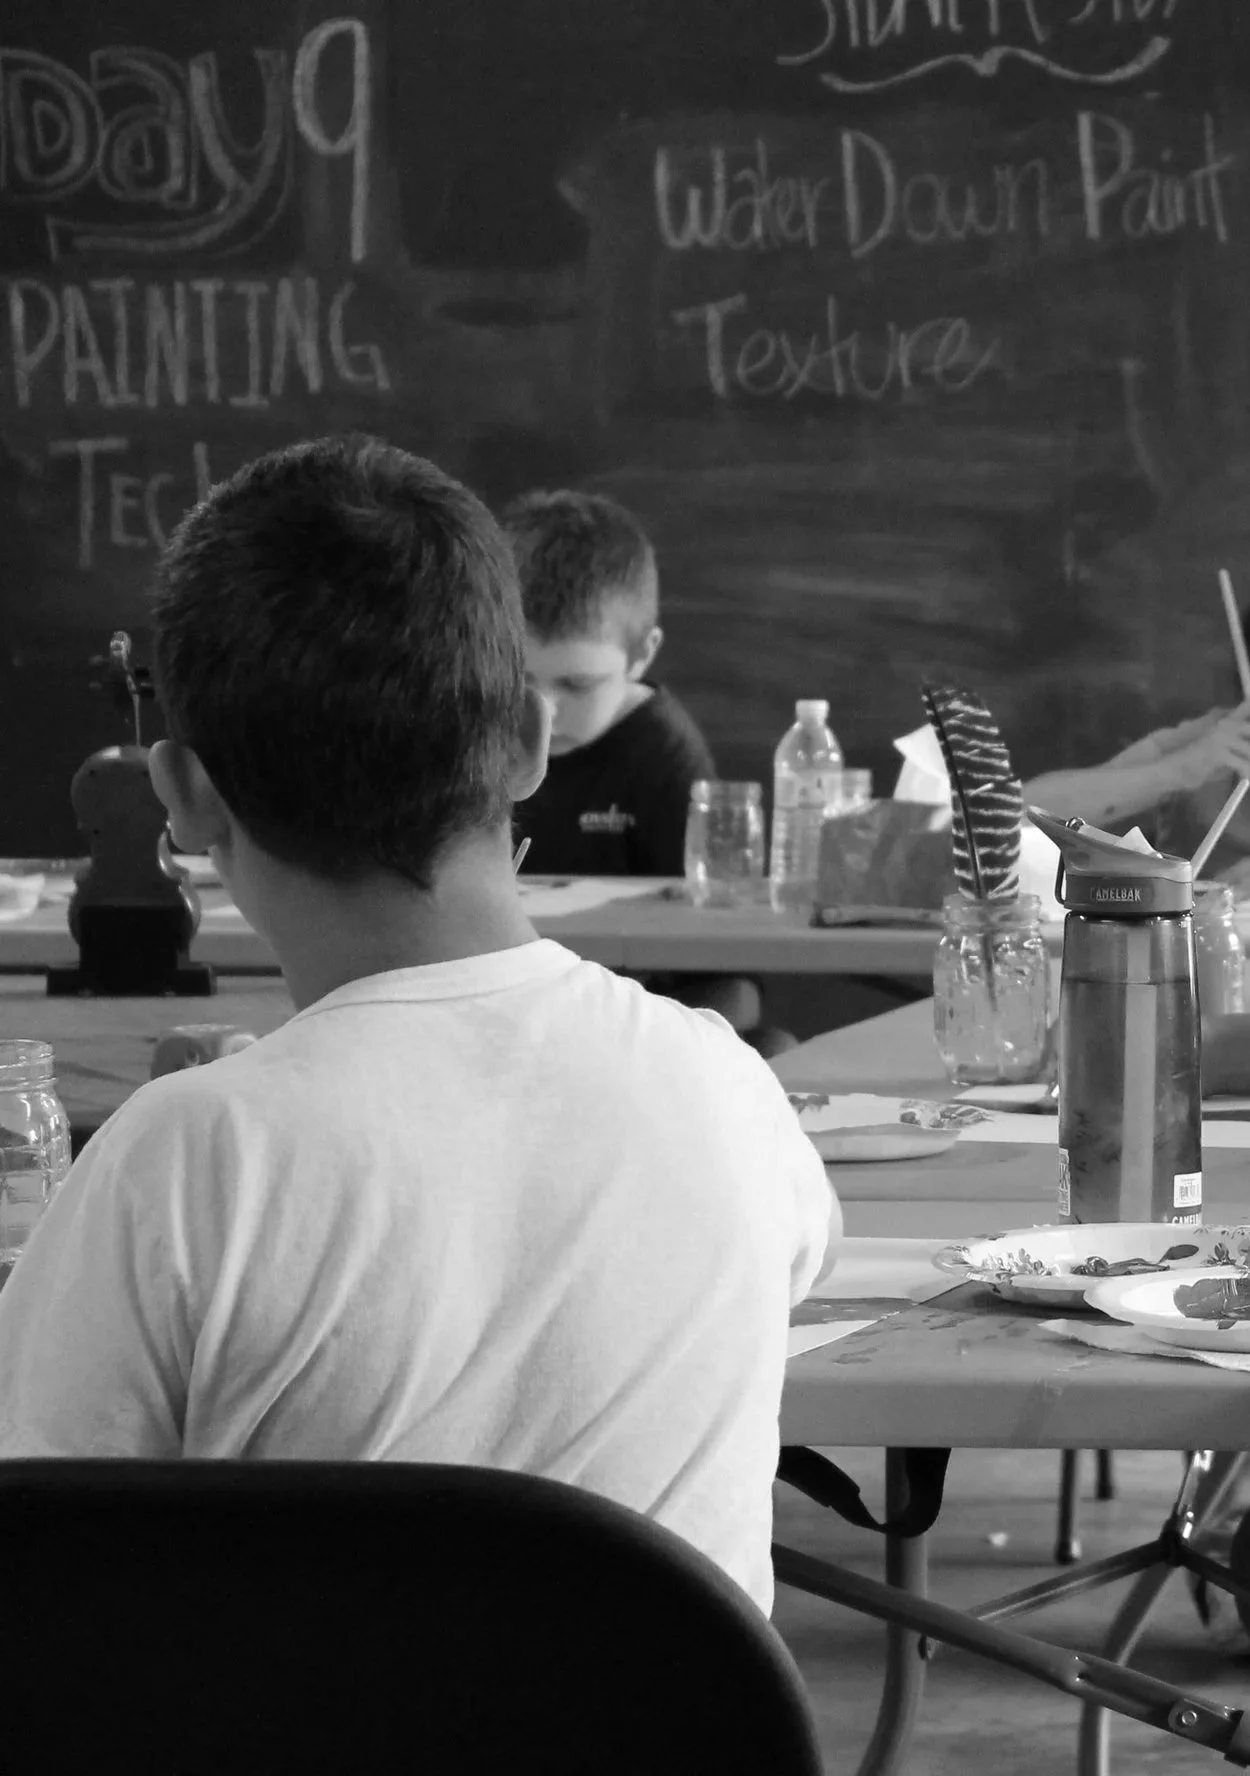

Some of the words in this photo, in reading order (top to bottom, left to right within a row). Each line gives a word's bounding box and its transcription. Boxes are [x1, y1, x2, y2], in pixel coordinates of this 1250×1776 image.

[655, 136, 832, 250] Water
[842, 128, 1052, 258] Down
[1077, 111, 1236, 242] Paint
[10, 277, 391, 409] PAINTING
[672, 294, 1000, 399] Texture
